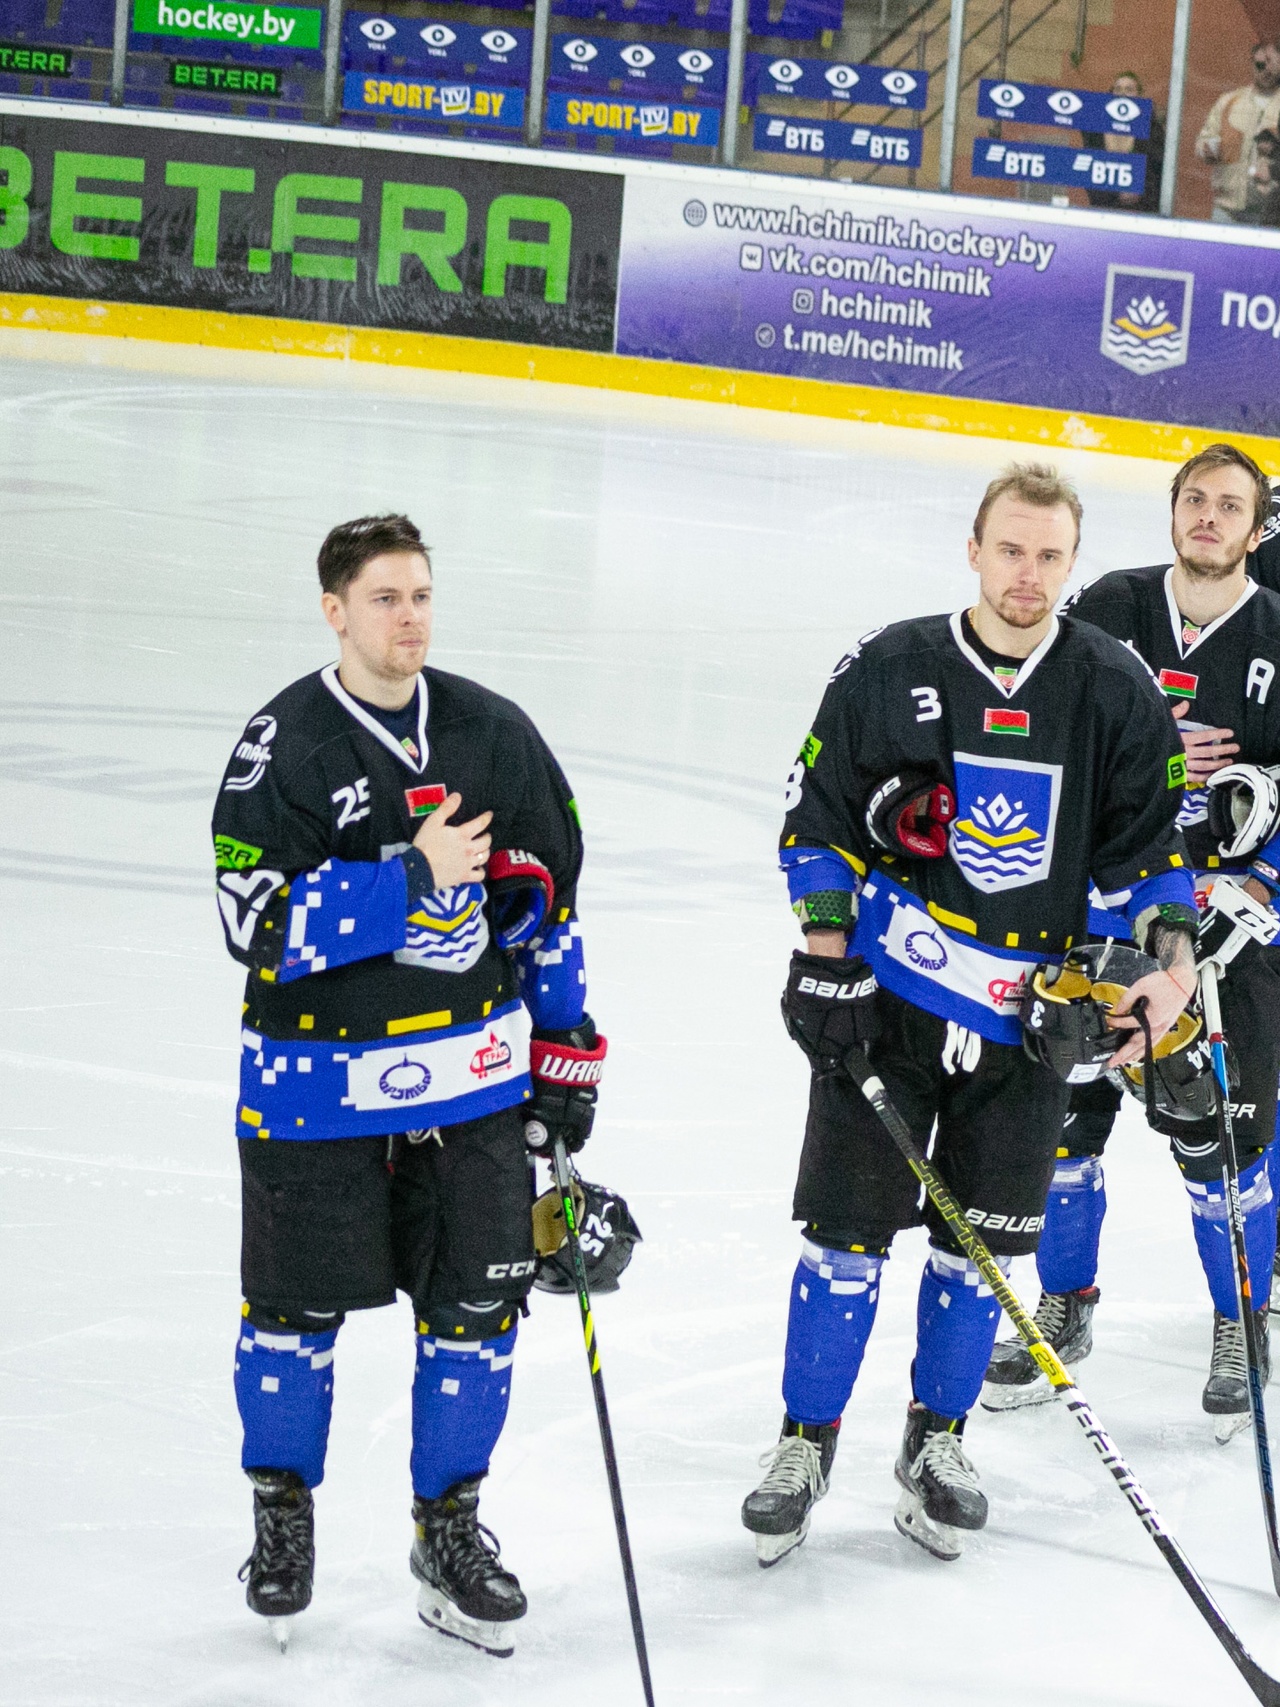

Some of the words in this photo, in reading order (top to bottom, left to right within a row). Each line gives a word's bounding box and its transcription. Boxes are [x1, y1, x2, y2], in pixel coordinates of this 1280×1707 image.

[158, 0, 296, 42] hockey.by
[0, 48, 66, 73] T.ERA
[785, 126, 825, 152] ВТБ
[870, 135, 910, 161] ВТБ
[1004, 151, 1045, 177] ВТБ
[1091, 160, 1133, 187] ВТБ
[714, 202, 1054, 271] www.hchimik.hockey.by
[769, 245, 992, 297] vk.com/hchimik
[821, 288, 932, 329] hchimik
[783, 323, 964, 371] t.me/hchimik
[1246, 657, 1275, 704] A
[910, 686, 942, 723] 3
[1029, 1001, 1046, 1028] 3
[964, 1207, 1046, 1233] BAUER
[1230, 1189, 1244, 1233] BAUER
[486, 1259, 537, 1280] CCM
